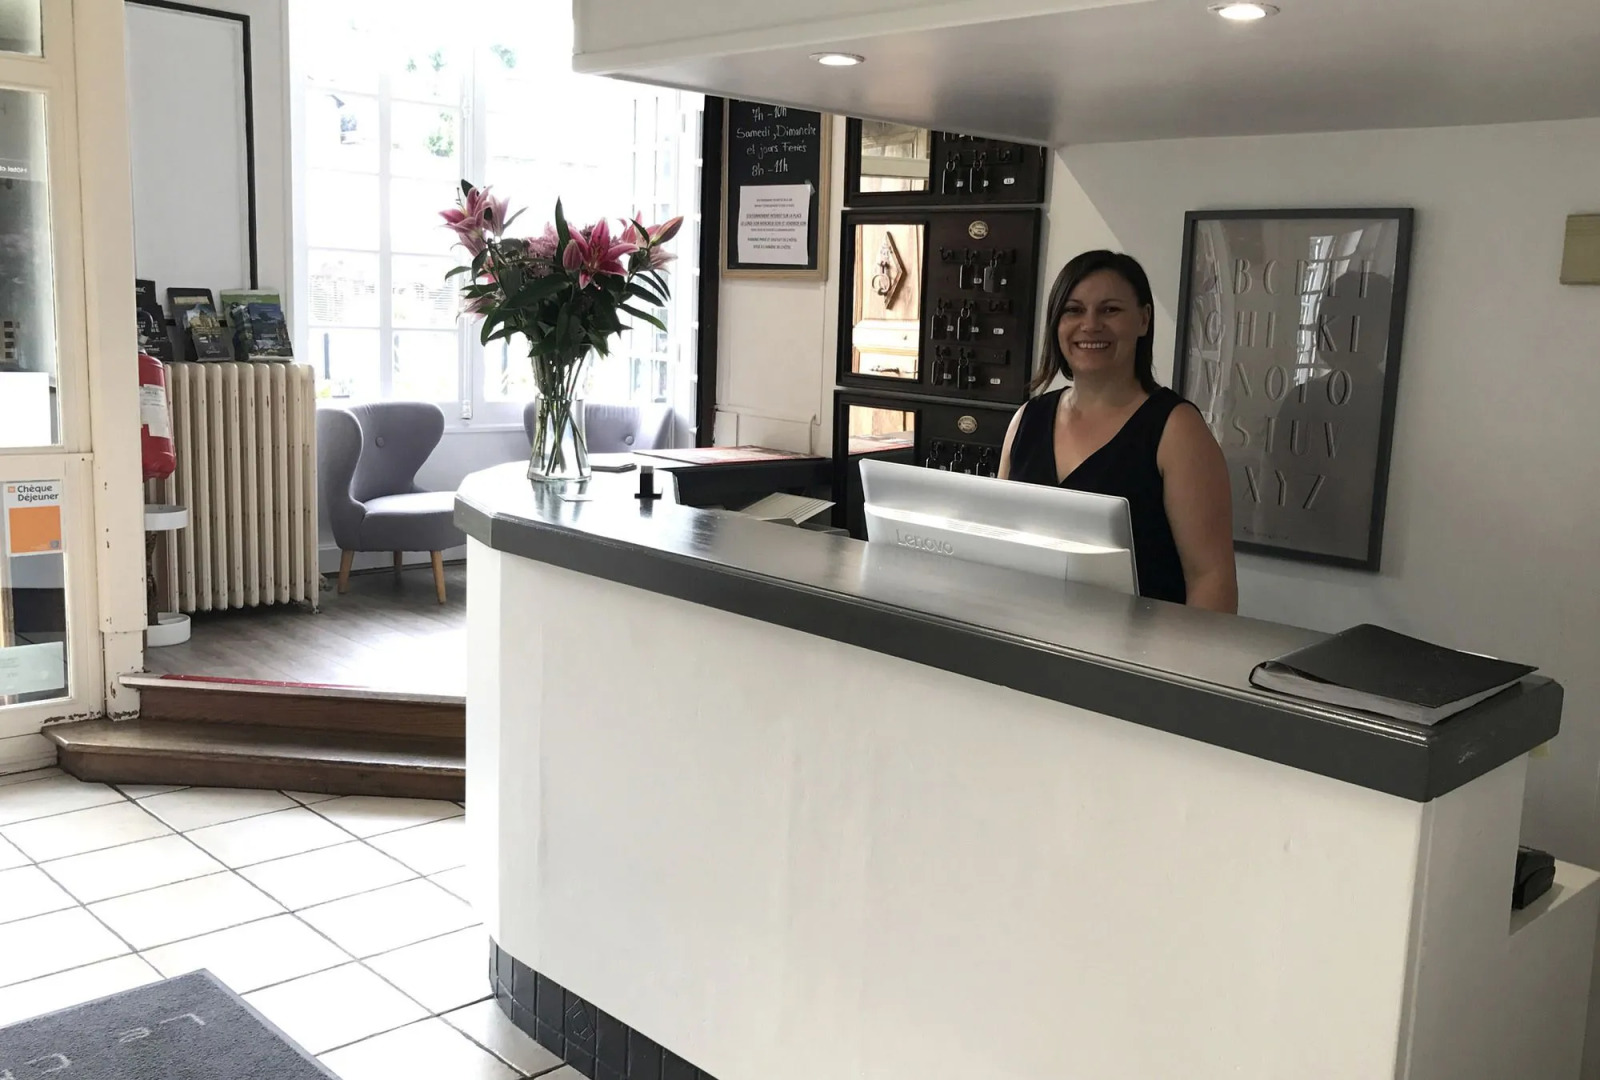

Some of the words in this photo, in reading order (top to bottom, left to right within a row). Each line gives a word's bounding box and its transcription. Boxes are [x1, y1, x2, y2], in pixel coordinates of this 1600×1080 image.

[736, 126, 771, 138] Samedi
[17, 485, 53, 493] Chèque
[17, 493, 59, 502] Déjeuner
[896, 528, 954, 555] Lenovo
